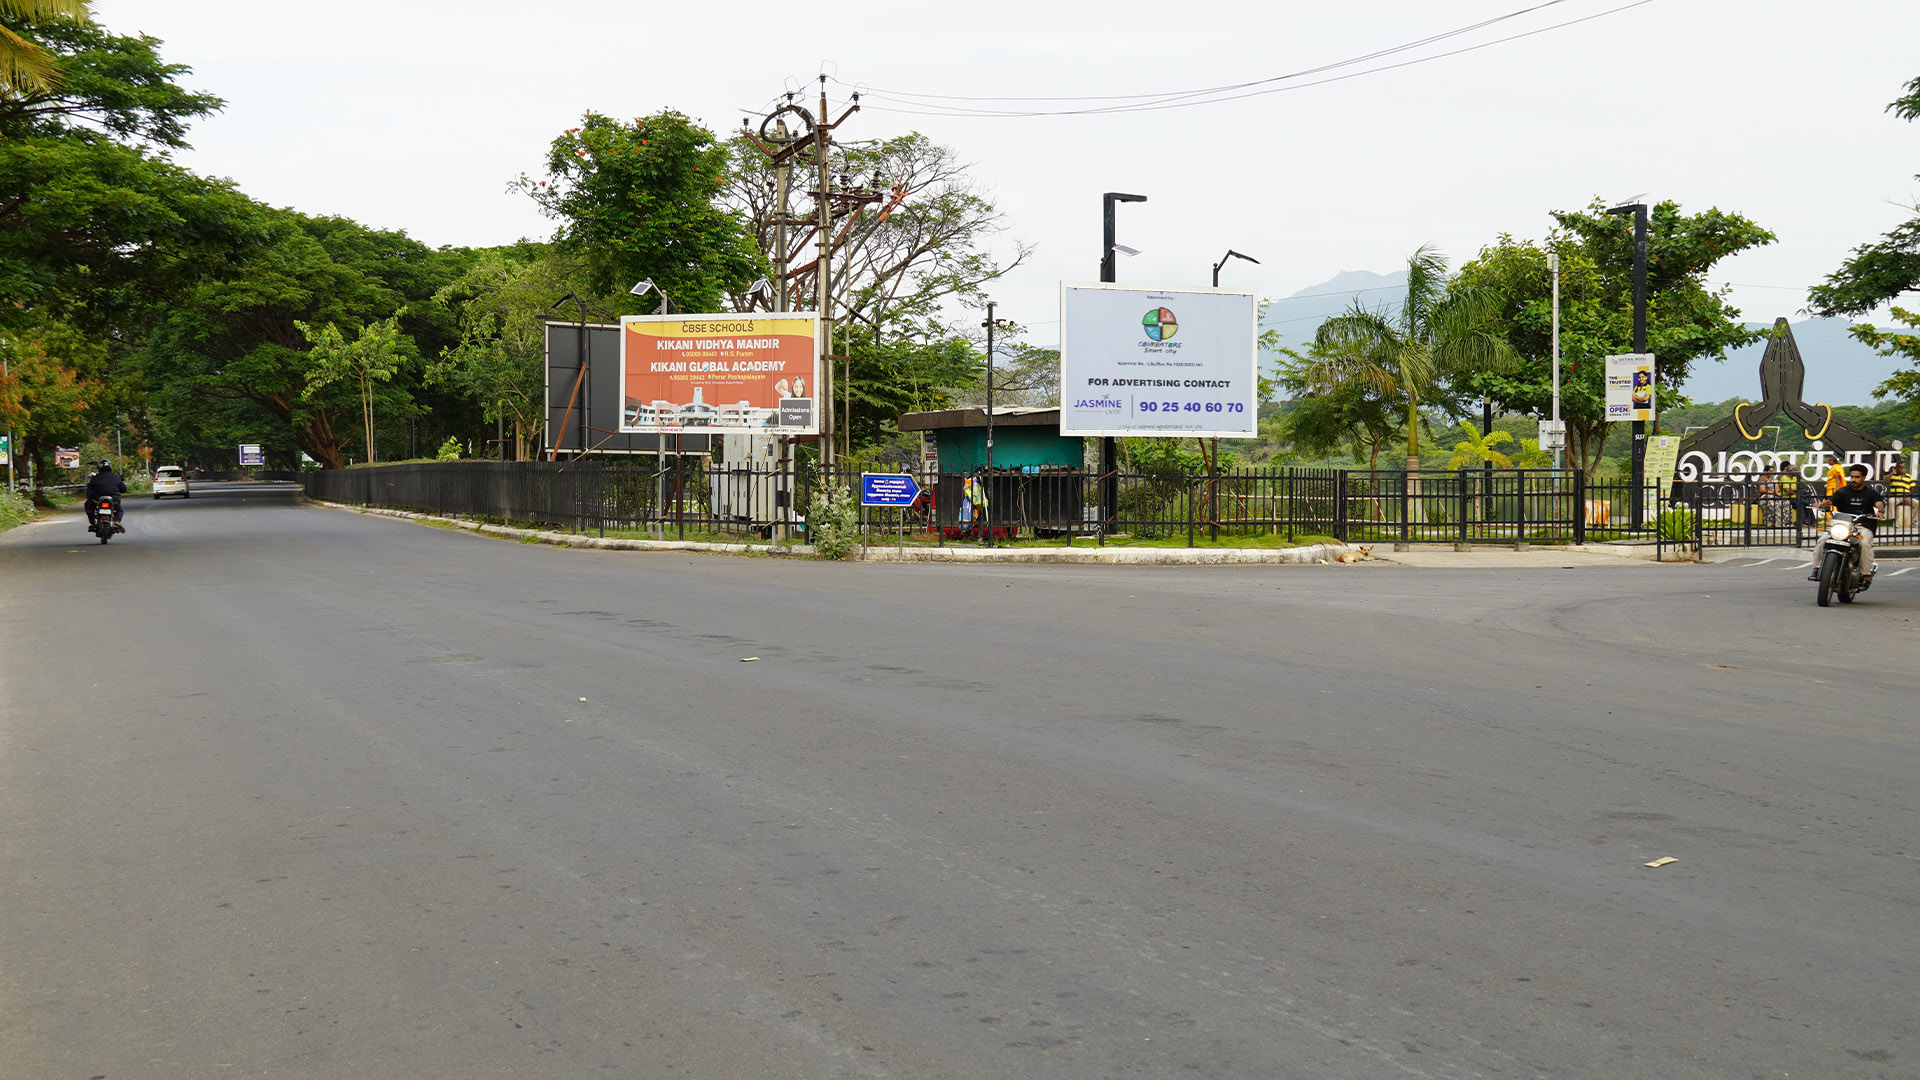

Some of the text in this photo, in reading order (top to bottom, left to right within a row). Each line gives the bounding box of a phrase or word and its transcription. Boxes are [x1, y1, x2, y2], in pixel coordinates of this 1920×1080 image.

[682, 322, 754, 333] CBSE SCHOOLS
[656, 338, 780, 350] KIKANI VIDHYA MANDIR
[1138, 341, 1183, 349] COIMBATORE
[650, 360, 787, 373] KIKANI GLOBAL ACADEMY
[1088, 378, 1231, 388] FOR ADVERTISING CONTACT
[1074, 399, 1123, 409] JASMINE
[1139, 401, 1244, 413] 90 25 40 60 70
[788, 414, 803, 422] Open
